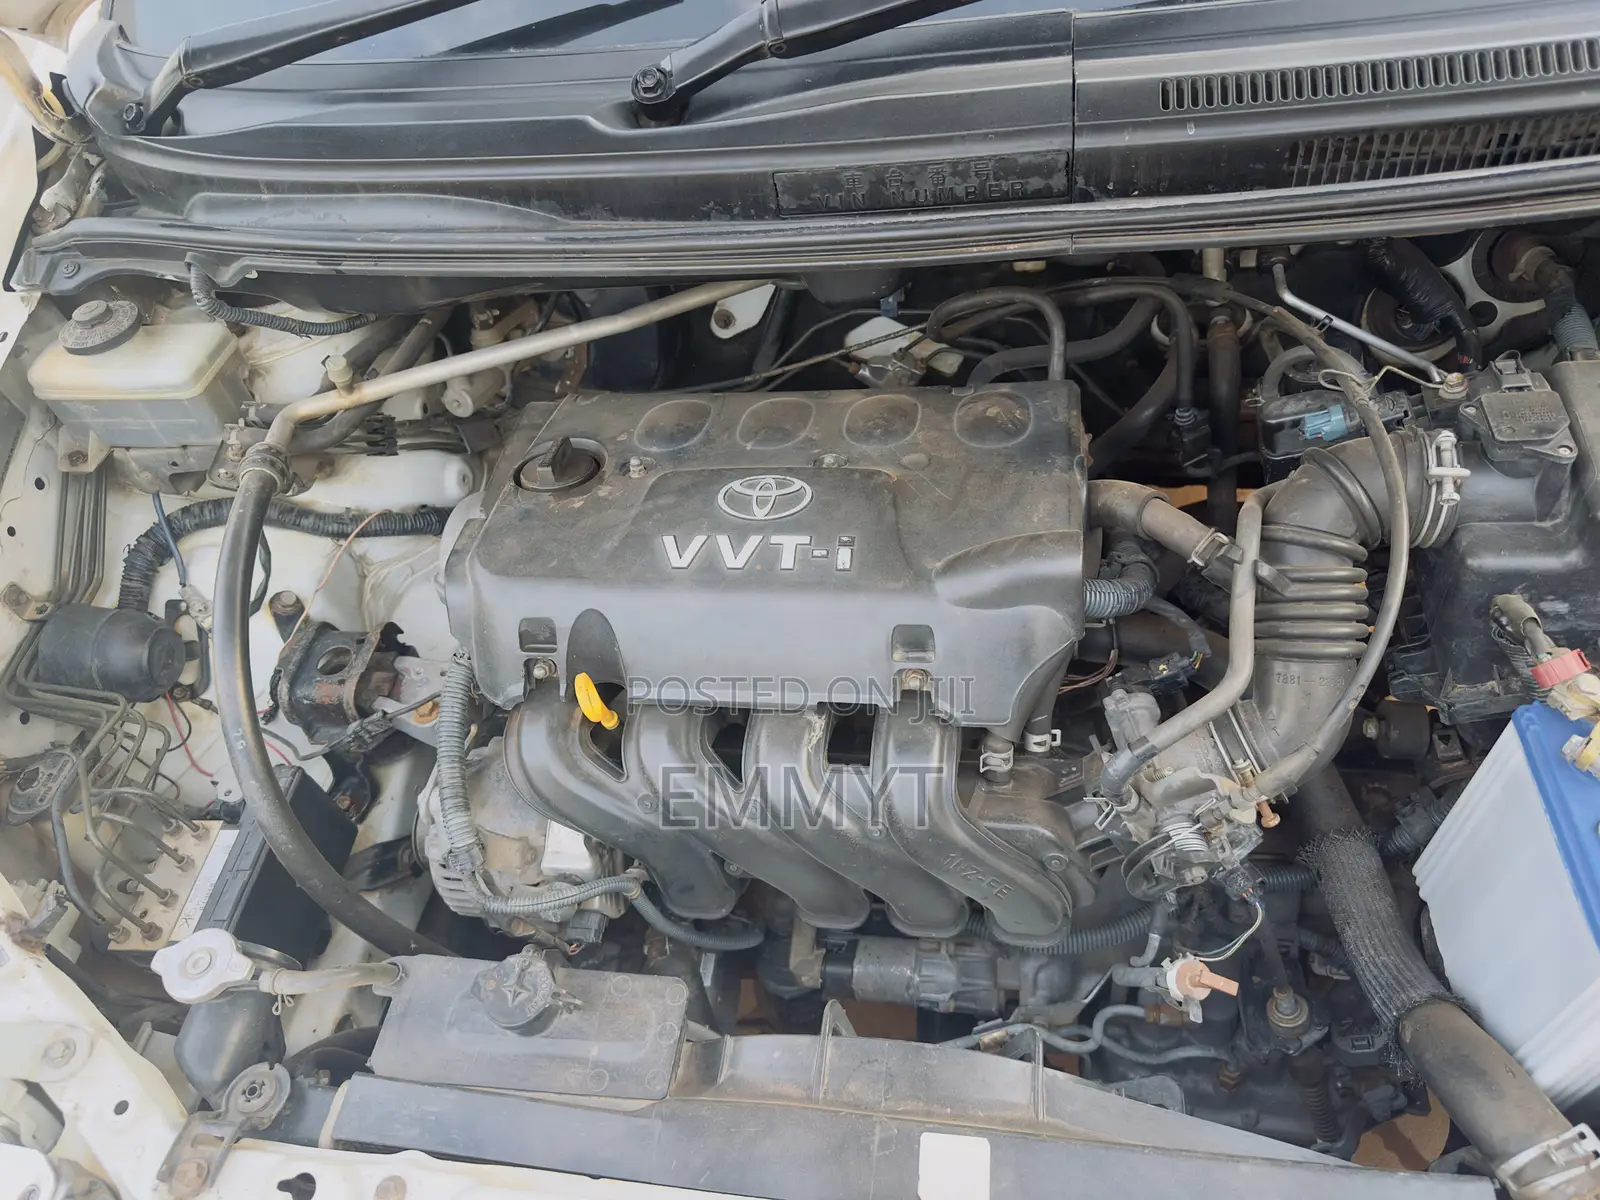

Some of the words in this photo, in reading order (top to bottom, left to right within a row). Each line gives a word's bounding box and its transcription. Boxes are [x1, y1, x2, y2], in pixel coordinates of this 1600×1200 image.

[816, 191, 867, 210] VIN
[891, 181, 1025, 203] NUMBER
[661, 534, 856, 571] VVT-i
